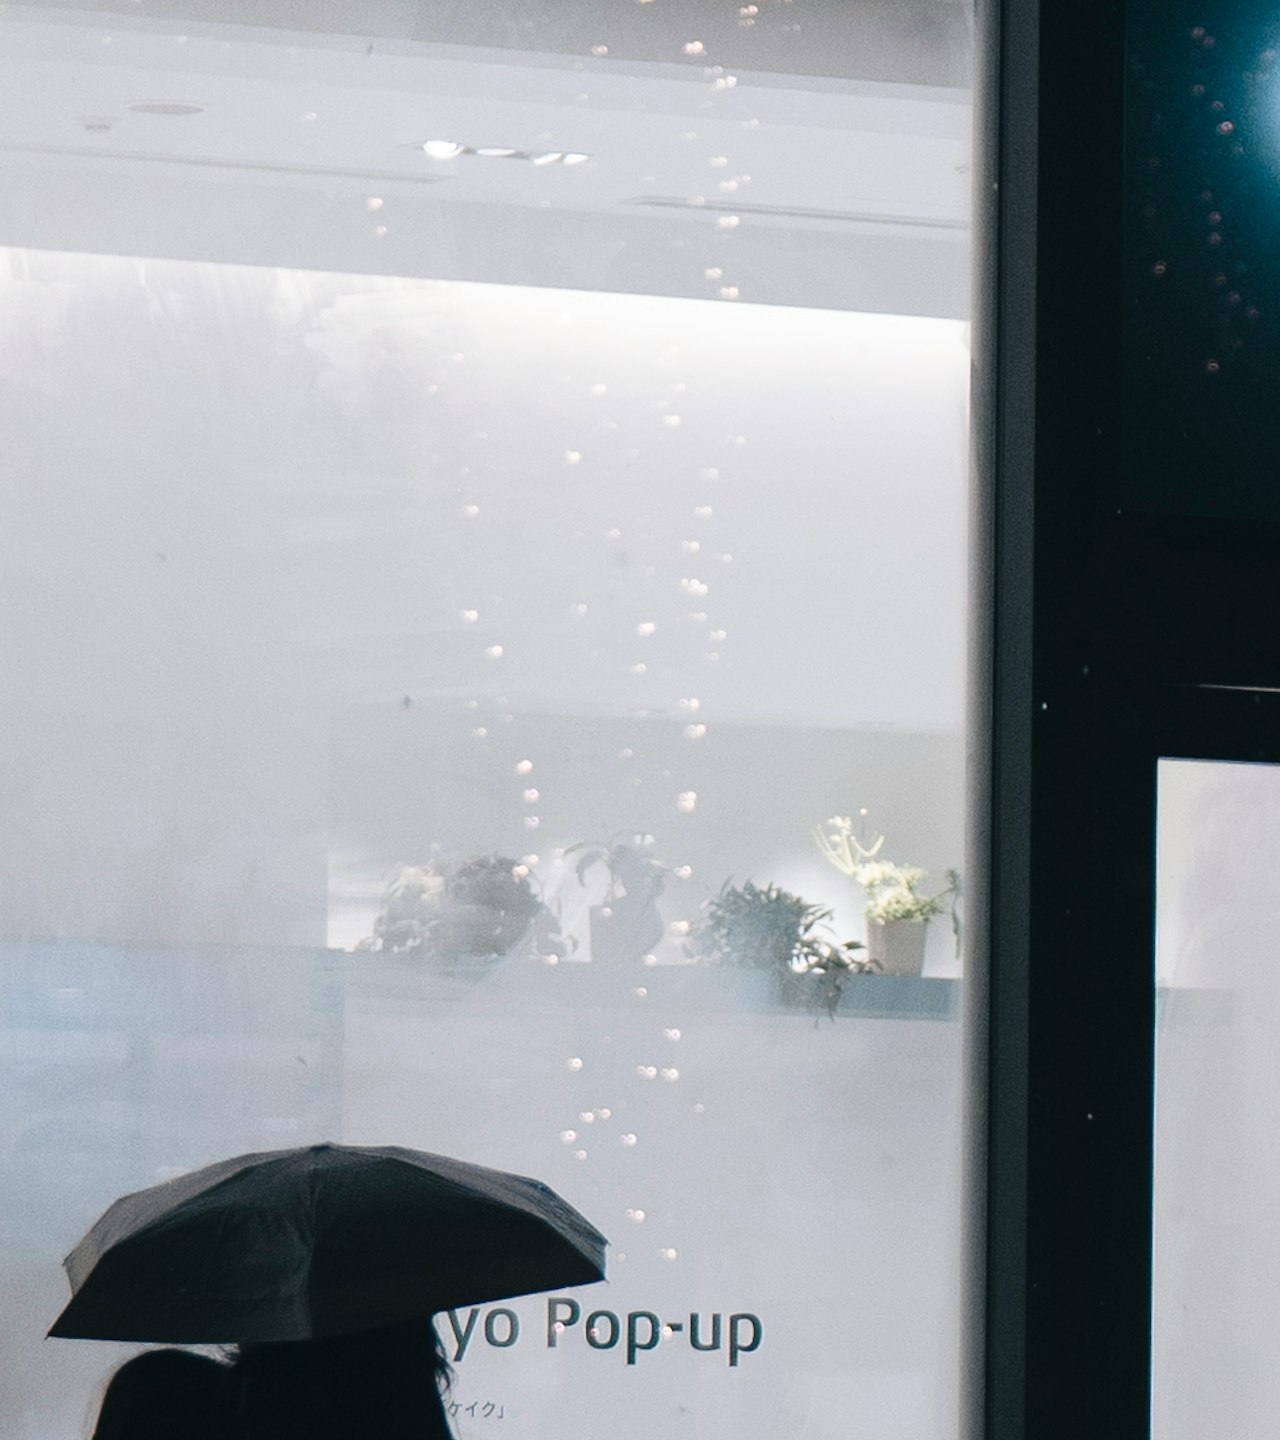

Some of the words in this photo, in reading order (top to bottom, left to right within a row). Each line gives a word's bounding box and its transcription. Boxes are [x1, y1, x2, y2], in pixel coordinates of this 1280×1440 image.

[547, 1297, 763, 1367] Pop-up
[443, 1400, 505, 1420] ケイク」
